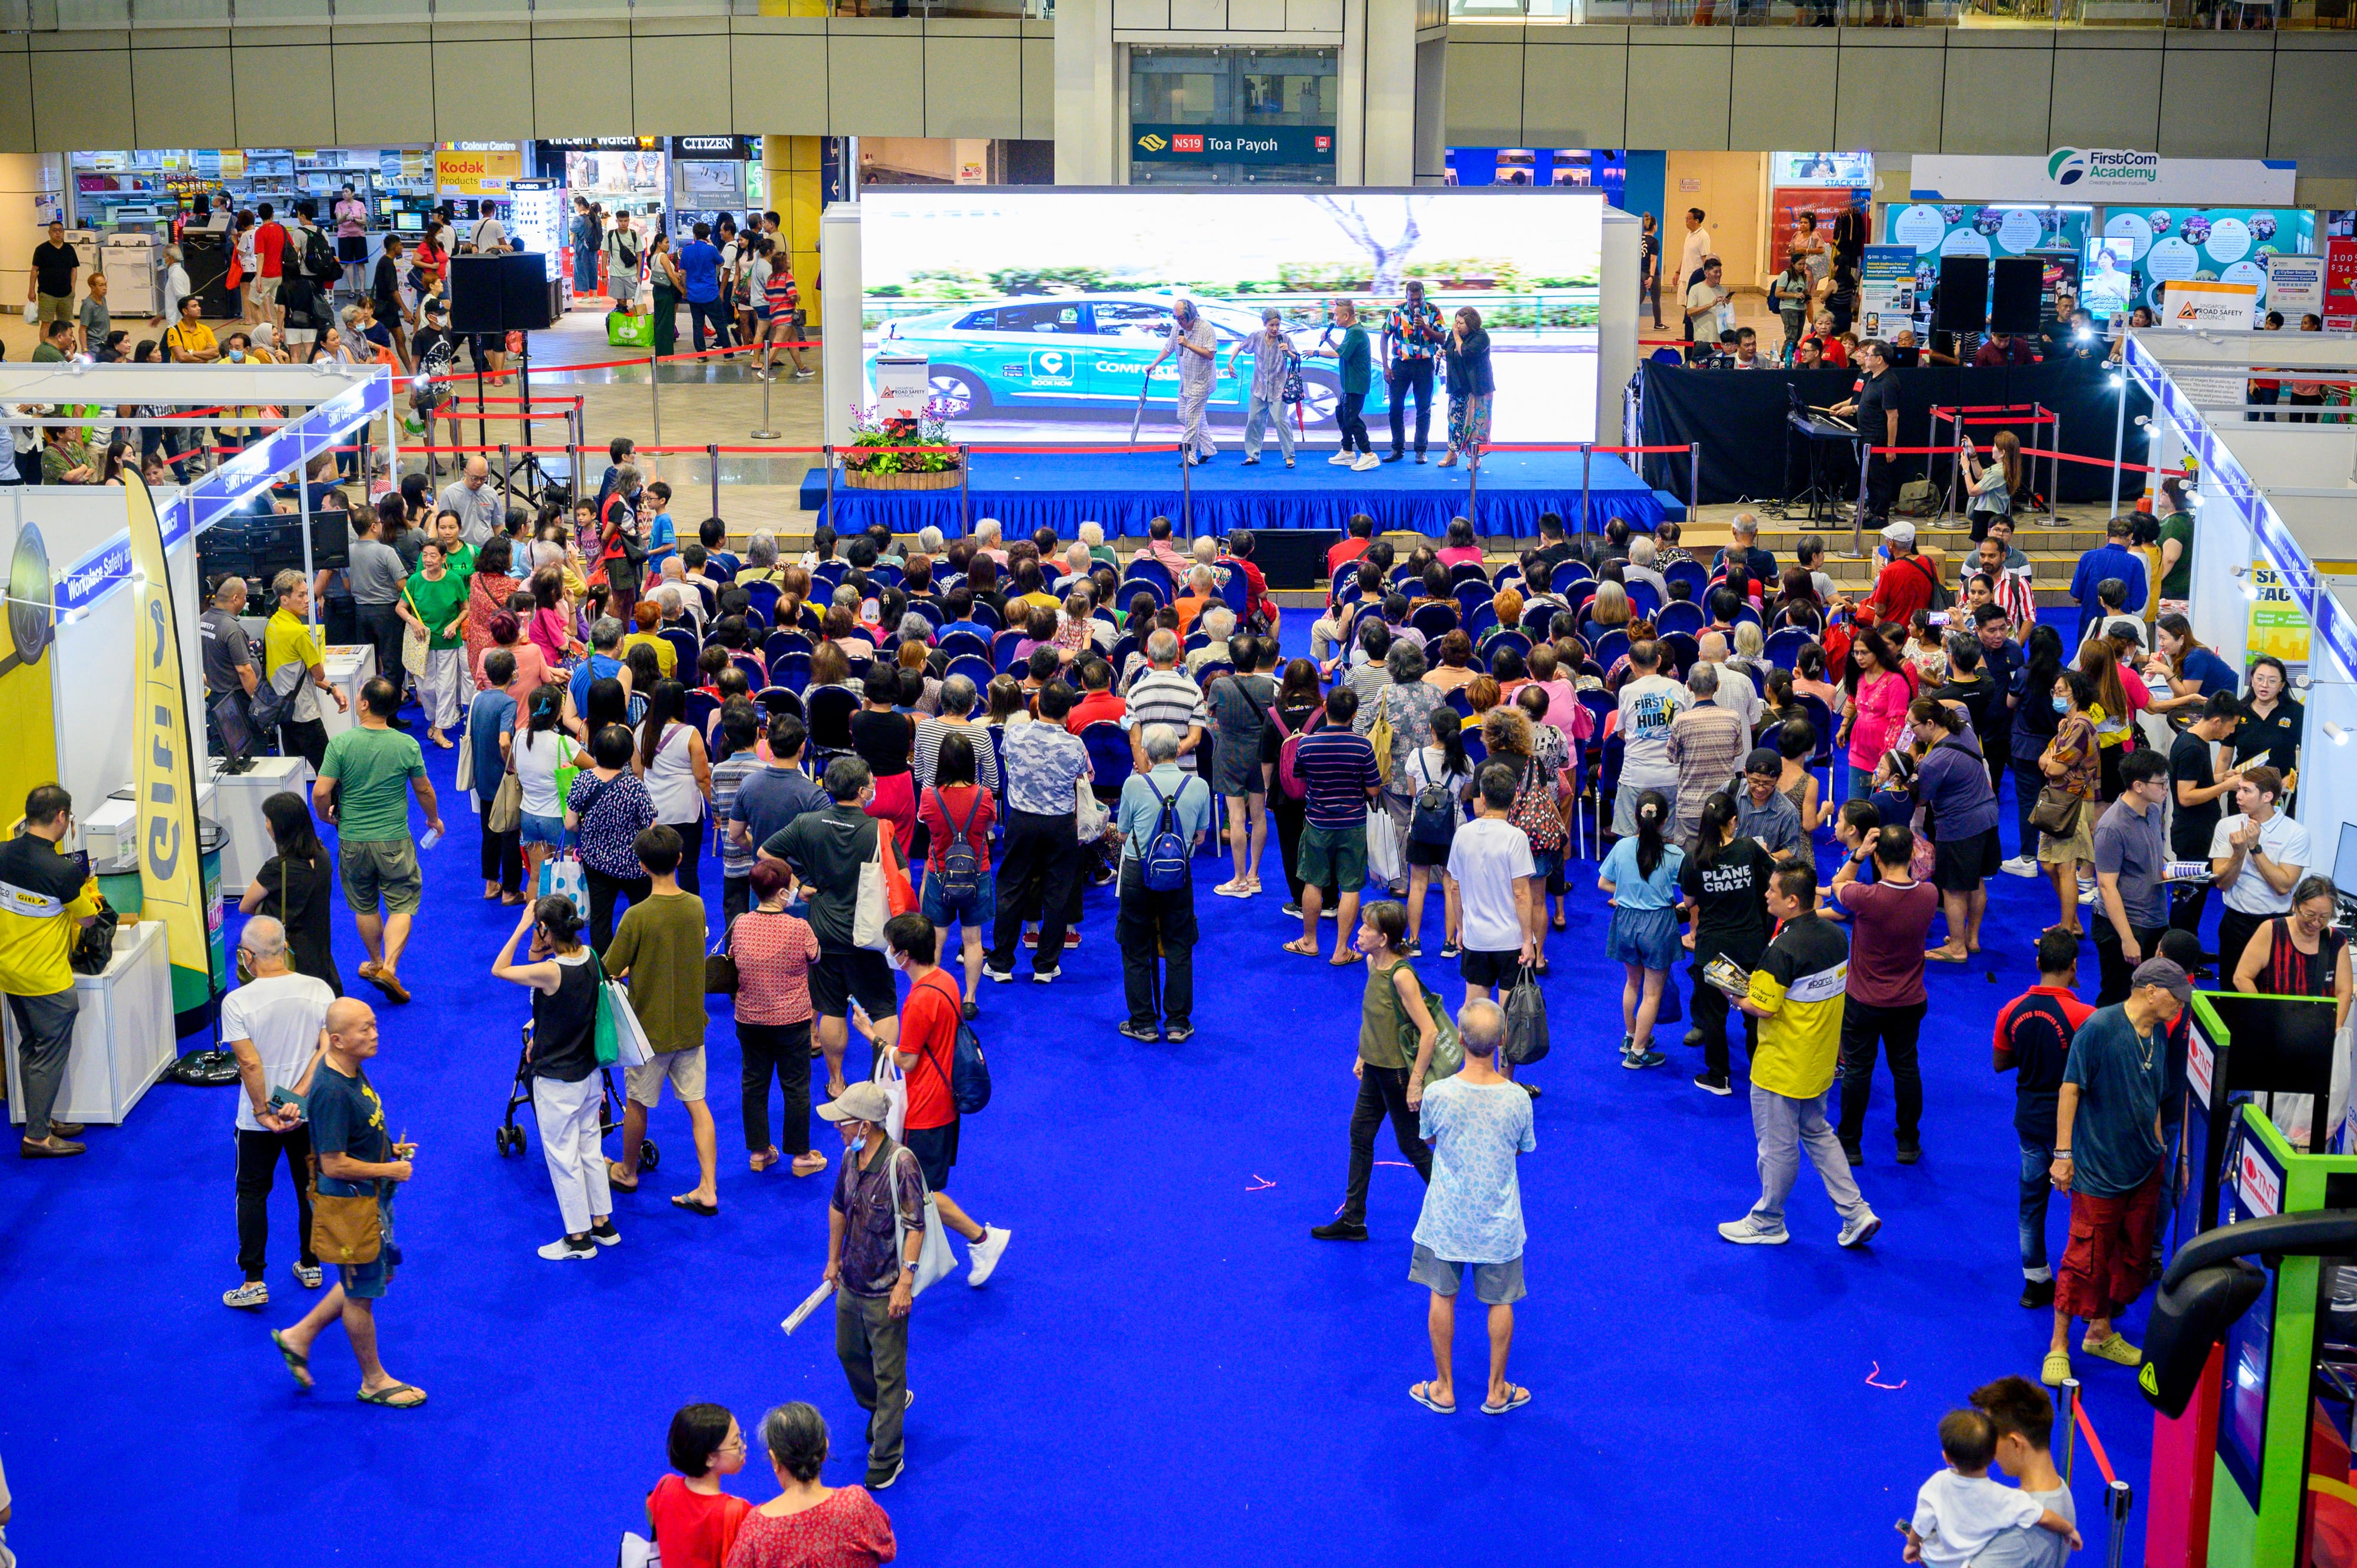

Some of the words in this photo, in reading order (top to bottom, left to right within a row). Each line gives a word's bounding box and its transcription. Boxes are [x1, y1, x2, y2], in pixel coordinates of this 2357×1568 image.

[441, 141, 461, 150] AMK
[461, 141, 488, 151] Colour
[489, 141, 516, 151] Centre
[682, 137, 733, 149] CITIZEN
[1175, 139, 1201, 148] NS19
[1209, 138, 1232, 150] Toa
[1237, 138, 1277, 153] Payoh
[2090, 152, 2157, 165] FirstCom
[440, 161, 484, 173] Kodak
[2089, 166, 2157, 182] Academy
[440, 176, 478, 184] Products
[1794, 201, 1825, 212] EVERYDAY
[2333, 254, 2357, 262] 100
[328, 406, 341, 428] SMRT
[225, 468, 240, 494] SMRT
[67, 565, 103, 602] Workplace
[103, 550, 124, 577] Safety
[160, 510, 178, 538] ouncil
[1635, 696, 1665, 710] FIRST
[1637, 712, 1667, 729] HUB
[1702, 864, 1751, 882] PLANE
[1703, 876, 1752, 892] CRAZY
[18, 894, 35, 903] Giti
[1807, 975, 1834, 990] sparco
[2034, 1010, 2058, 1026] SERVICES
[2198, 1047, 2213, 1078] TNT
[2257, 1169, 2279, 1204] TNT
